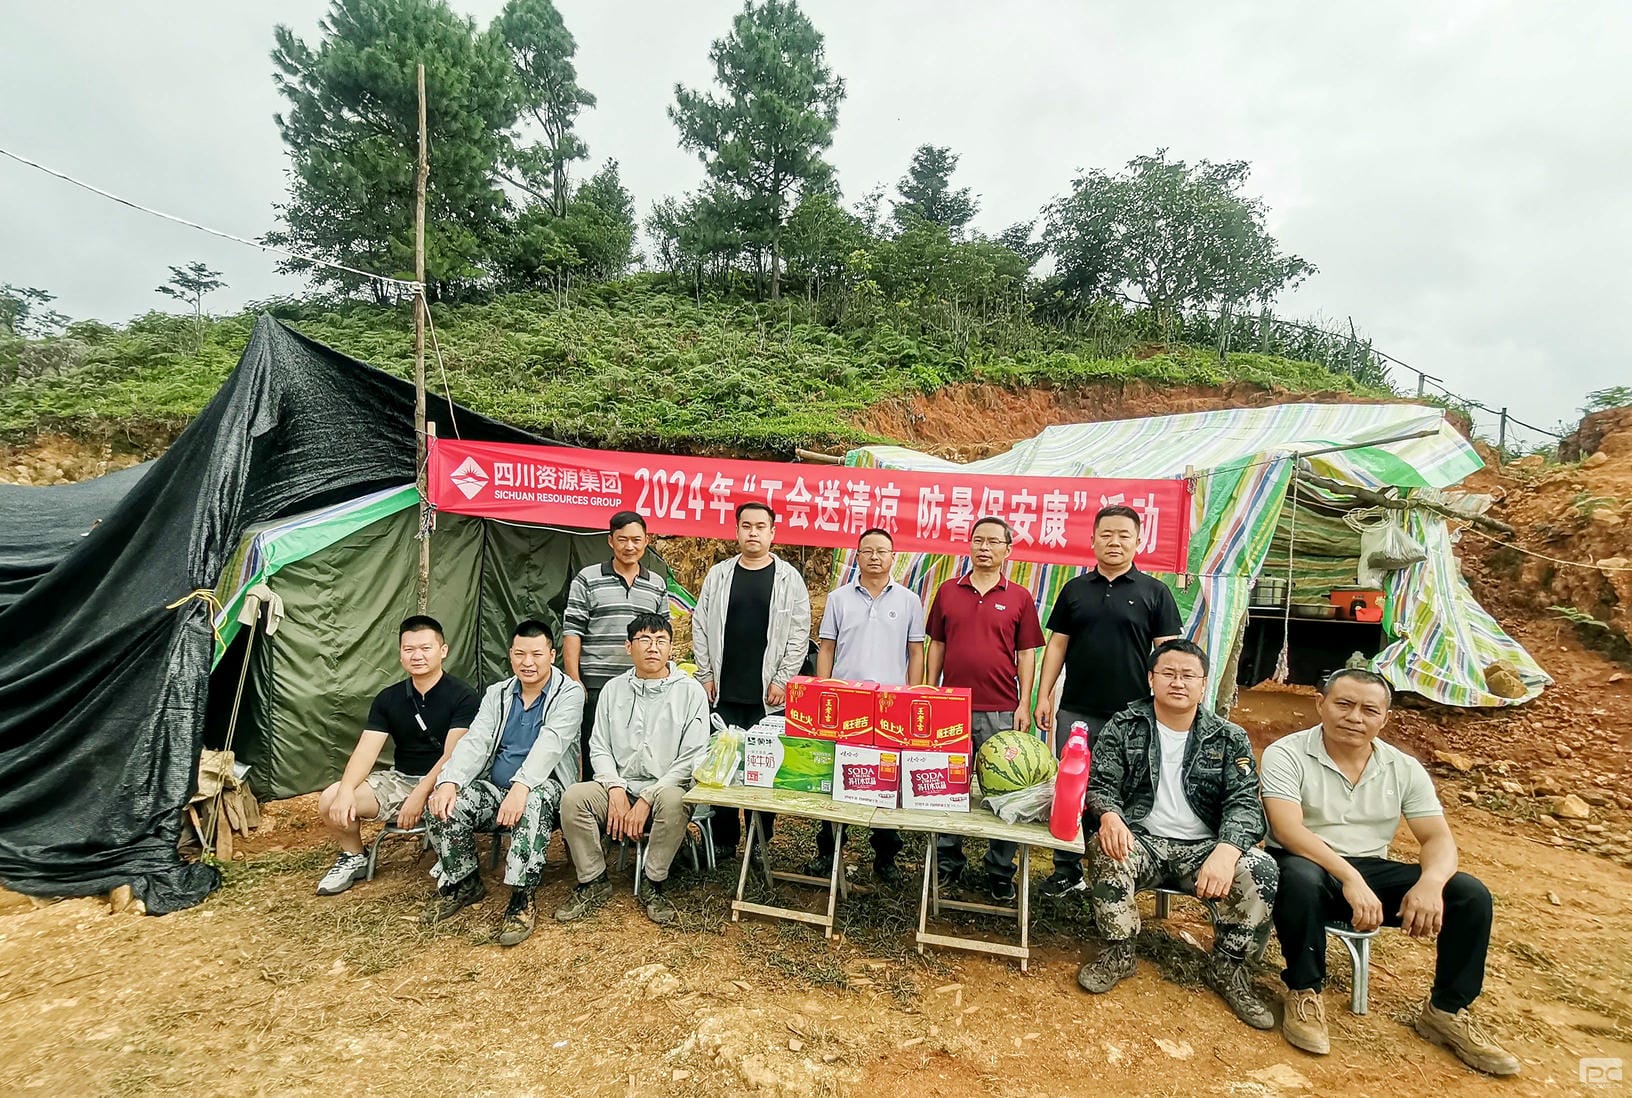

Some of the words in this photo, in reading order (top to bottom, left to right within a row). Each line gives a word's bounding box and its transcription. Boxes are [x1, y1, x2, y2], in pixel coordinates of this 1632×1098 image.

[493, 462, 622, 494] 四川资源集团
[494, 490, 535, 502] SICHUAN
[536, 493, 589, 506] RESOURCES
[590, 496, 622, 508] GROUP
[880, 719, 904, 736] 怕上火
[747, 754, 776, 769] 纯牛奶
[847, 767, 875, 776] SODA
[915, 771, 945, 781] SODA
